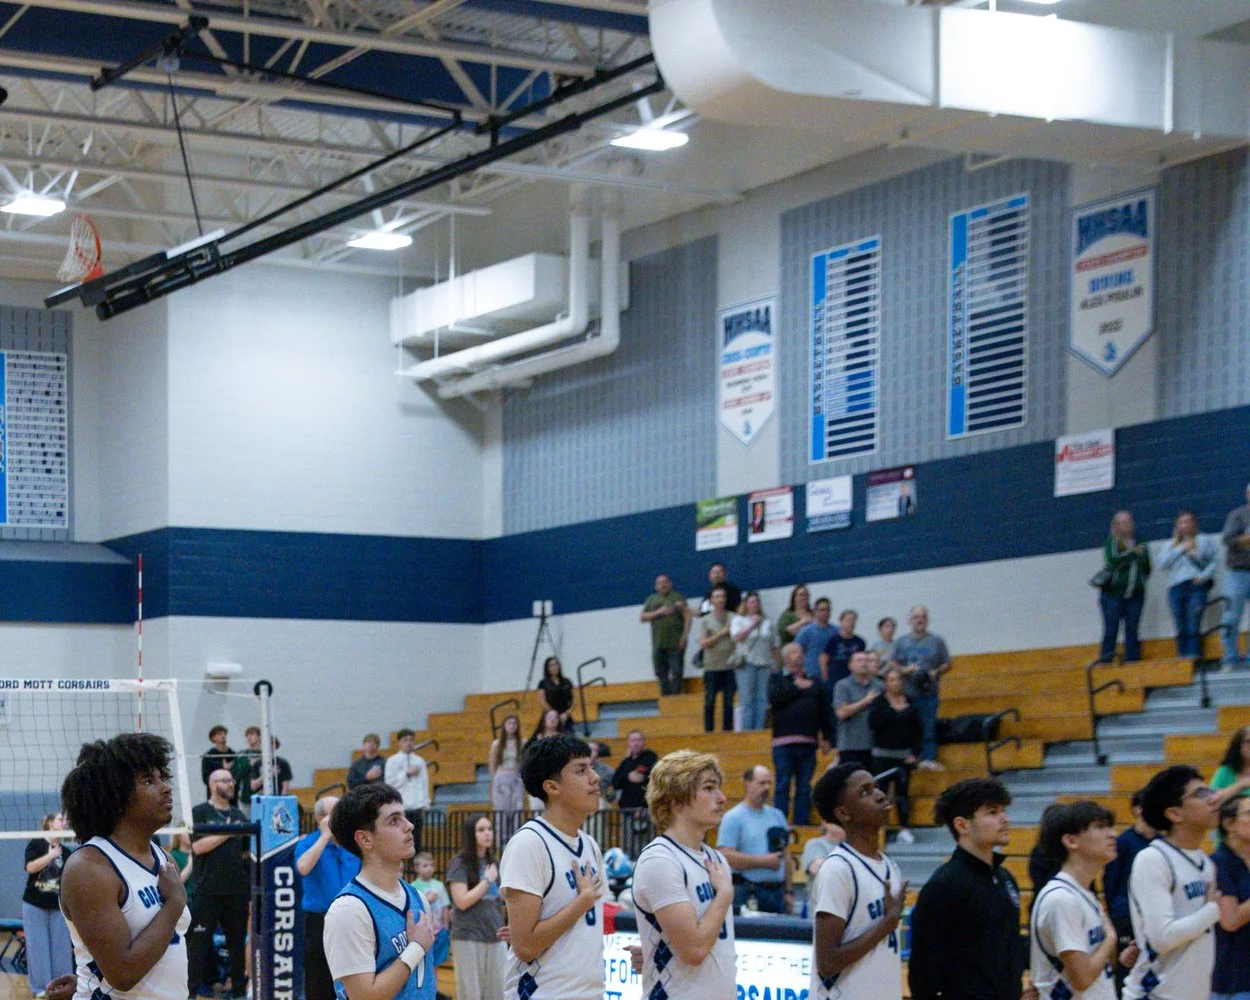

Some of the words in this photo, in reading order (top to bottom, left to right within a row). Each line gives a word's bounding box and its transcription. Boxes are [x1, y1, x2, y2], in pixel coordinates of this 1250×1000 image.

[813, 302, 824, 416] BASKETBALL
[952, 264, 965, 388] BASKETBALL
[24, 679, 52, 689] MOTT
[58, 680, 110, 690] CORSAIRS
